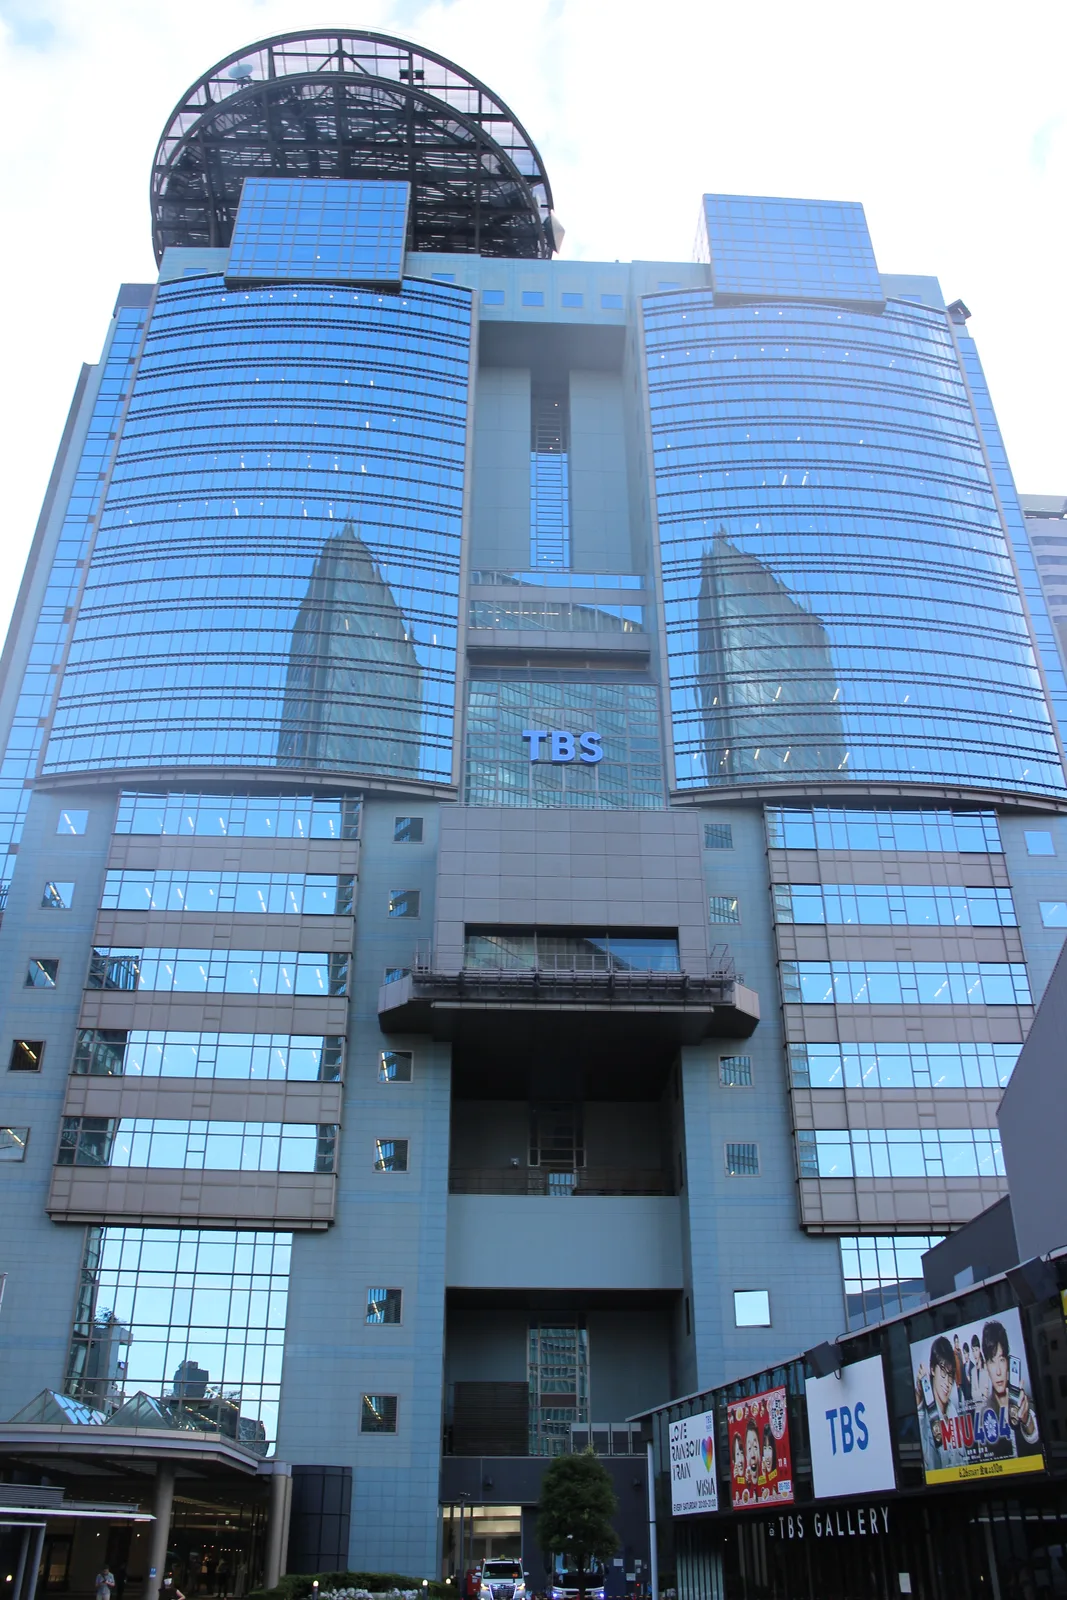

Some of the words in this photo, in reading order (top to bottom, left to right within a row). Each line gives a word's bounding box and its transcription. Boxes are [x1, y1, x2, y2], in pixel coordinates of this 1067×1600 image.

[522, 730, 604, 763] TBS
[671, 1422, 688, 1442] LOVE
[825, 1401, 869, 1456] TBS
[940, 1406, 1011, 1451] MIU404
[671, 1439, 701, 1461] RAINBOW
[672, 1461, 692, 1481] TRAIN
[779, 1514, 804, 1539] TBS
[814, 1506, 889, 1537] GALLERY
